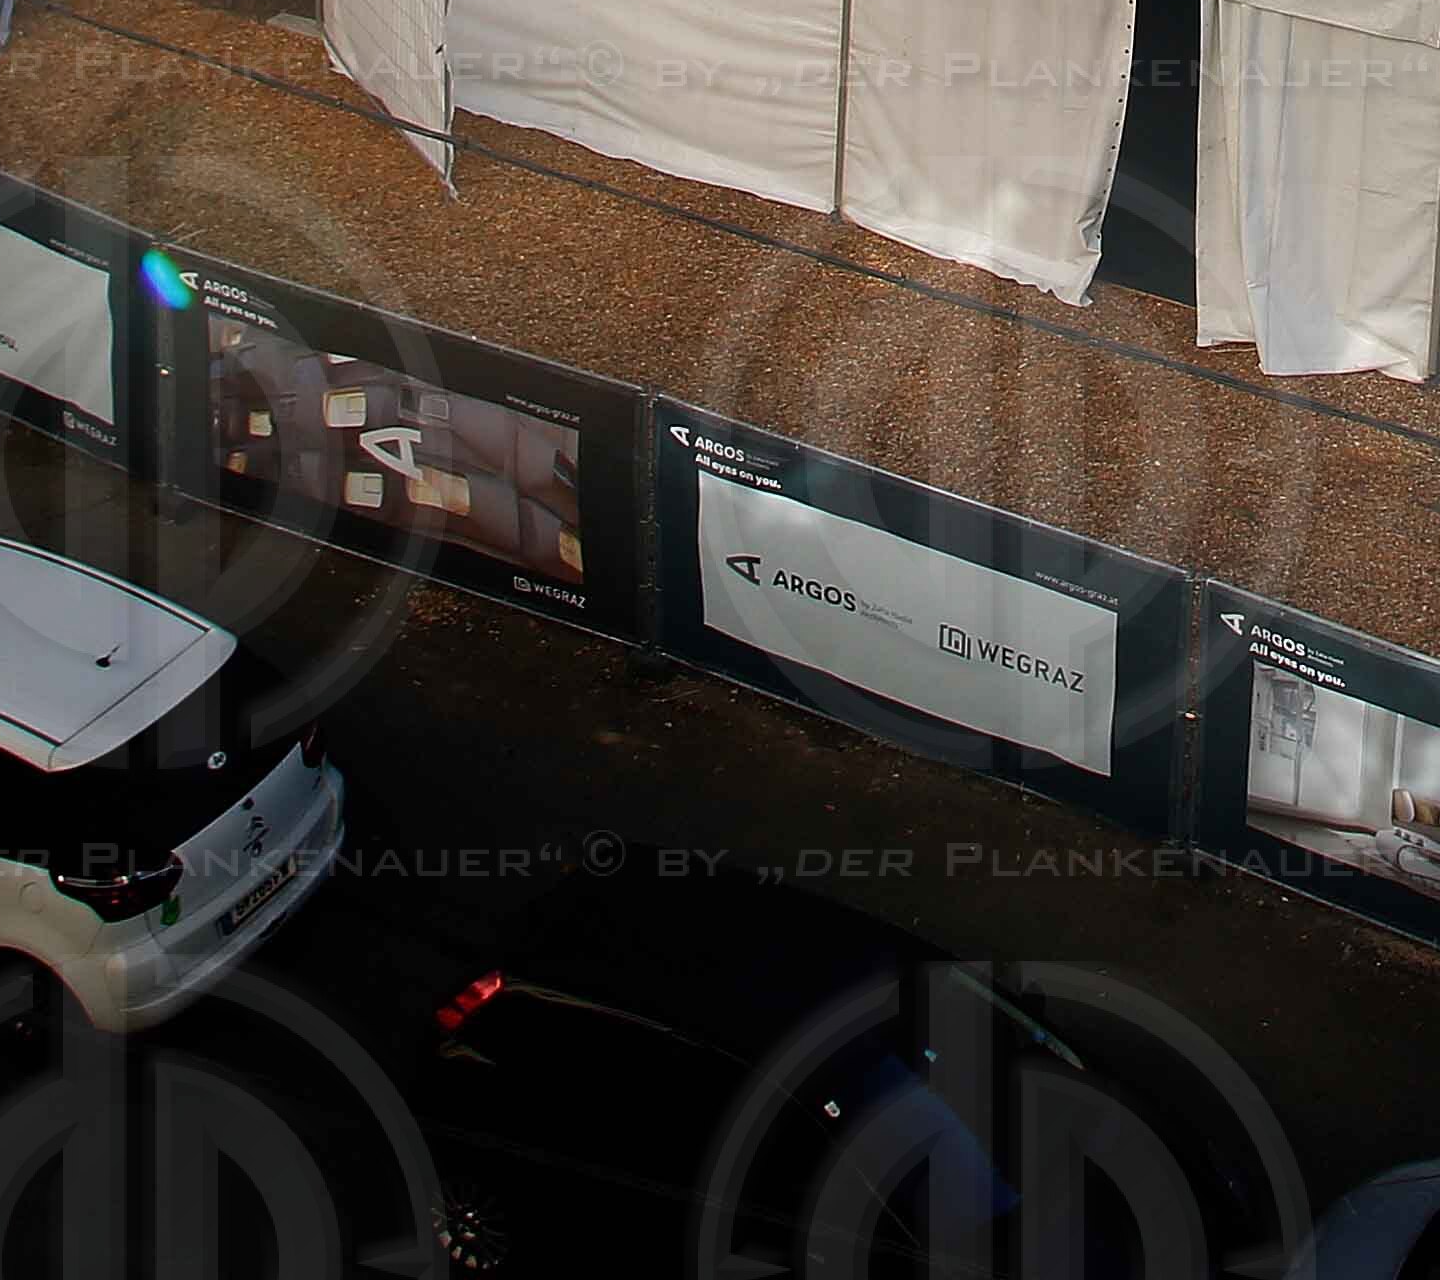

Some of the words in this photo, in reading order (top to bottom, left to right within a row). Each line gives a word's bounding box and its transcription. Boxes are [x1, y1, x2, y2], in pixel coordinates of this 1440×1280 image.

[203, 279, 249, 303] ARGOS
[694, 435, 746, 462] ARGOS
[695, 453, 711, 467] All
[739, 471, 754, 482] on
[533, 583, 586, 609] WEGRAZ
[771, 569, 858, 613] ARGOS
[1250, 624, 1307, 658] ARGOS
[976, 637, 1085, 694] WEGRAZ
[1248, 641, 1268, 657] All
[1269, 651, 1298, 671] eyes
[1298, 663, 1316, 677] on
[1316, 670, 1347, 688] you.
